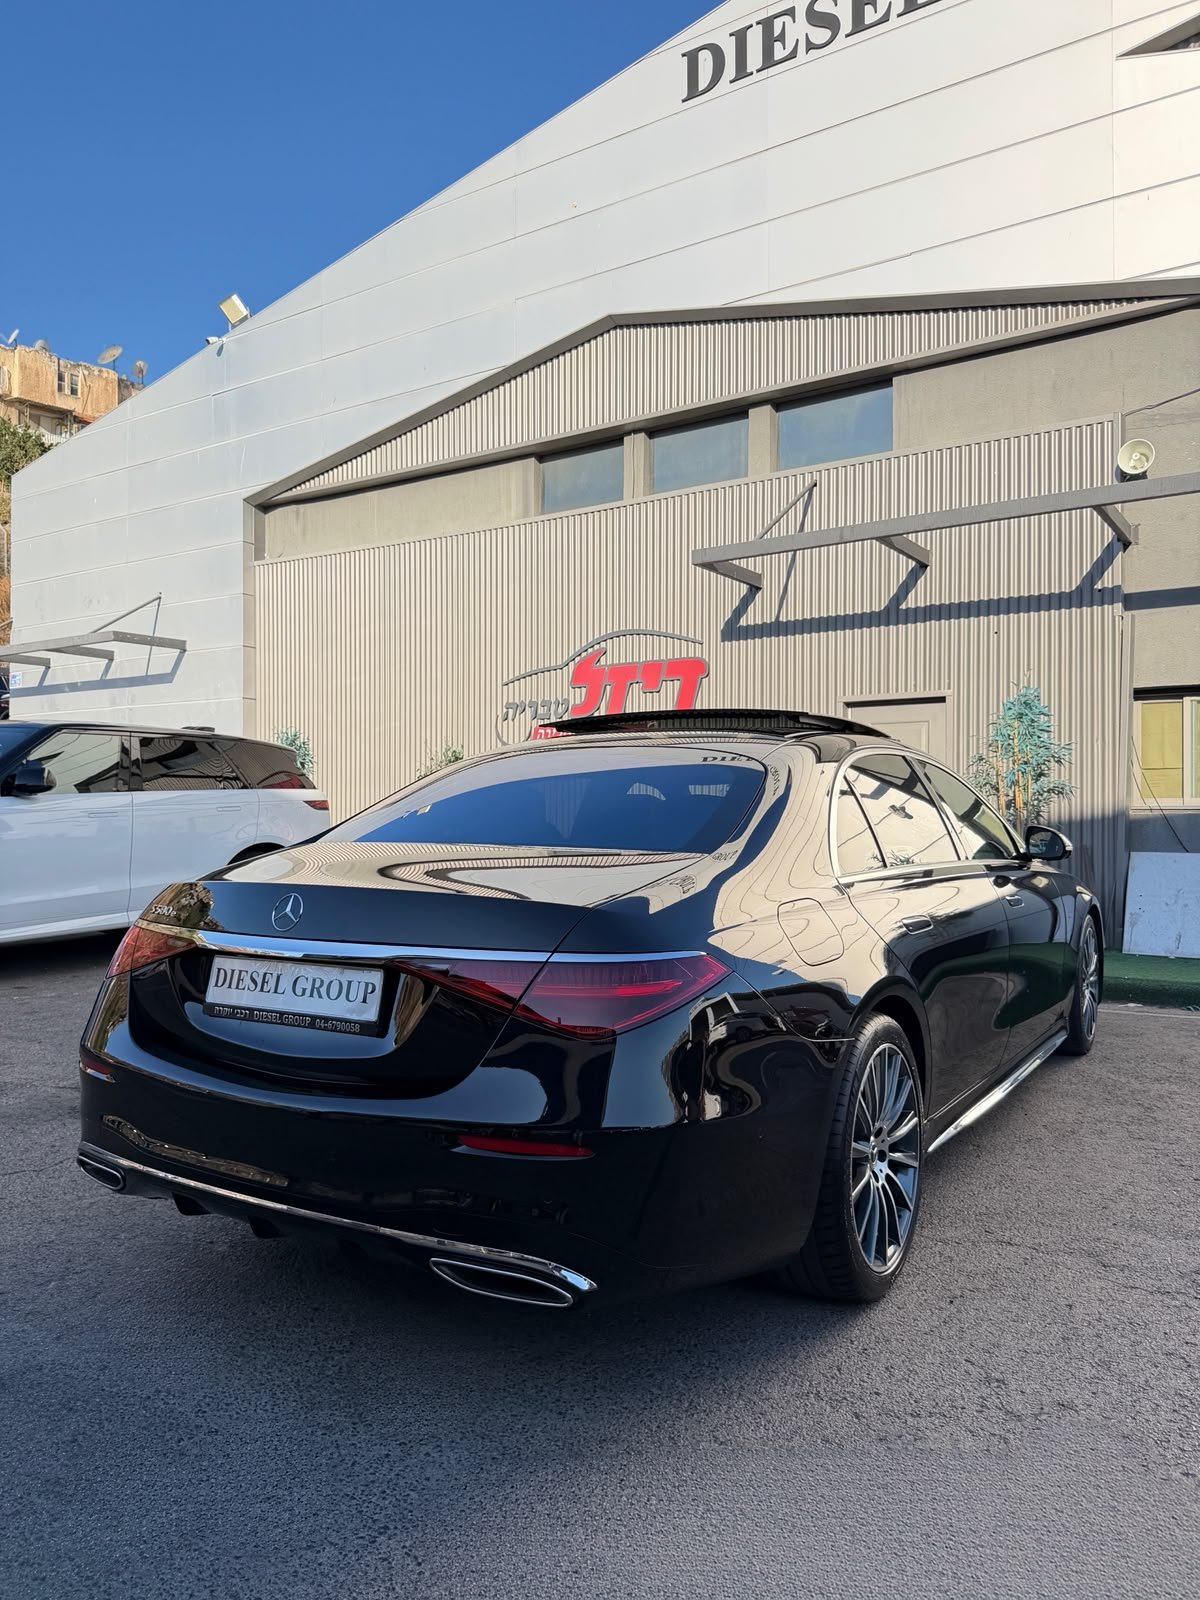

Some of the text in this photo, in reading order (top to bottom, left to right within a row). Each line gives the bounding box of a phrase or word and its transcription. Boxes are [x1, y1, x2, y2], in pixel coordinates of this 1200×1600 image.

[681, 0, 942, 103] DIESE
[501, 647, 709, 721] דיזל טבריה
[213, 967, 376, 1004] DIESEL GROUP
[214, 1006, 360, 1033] רכבי יוקרה DIESEL GROUP 04-6790058
